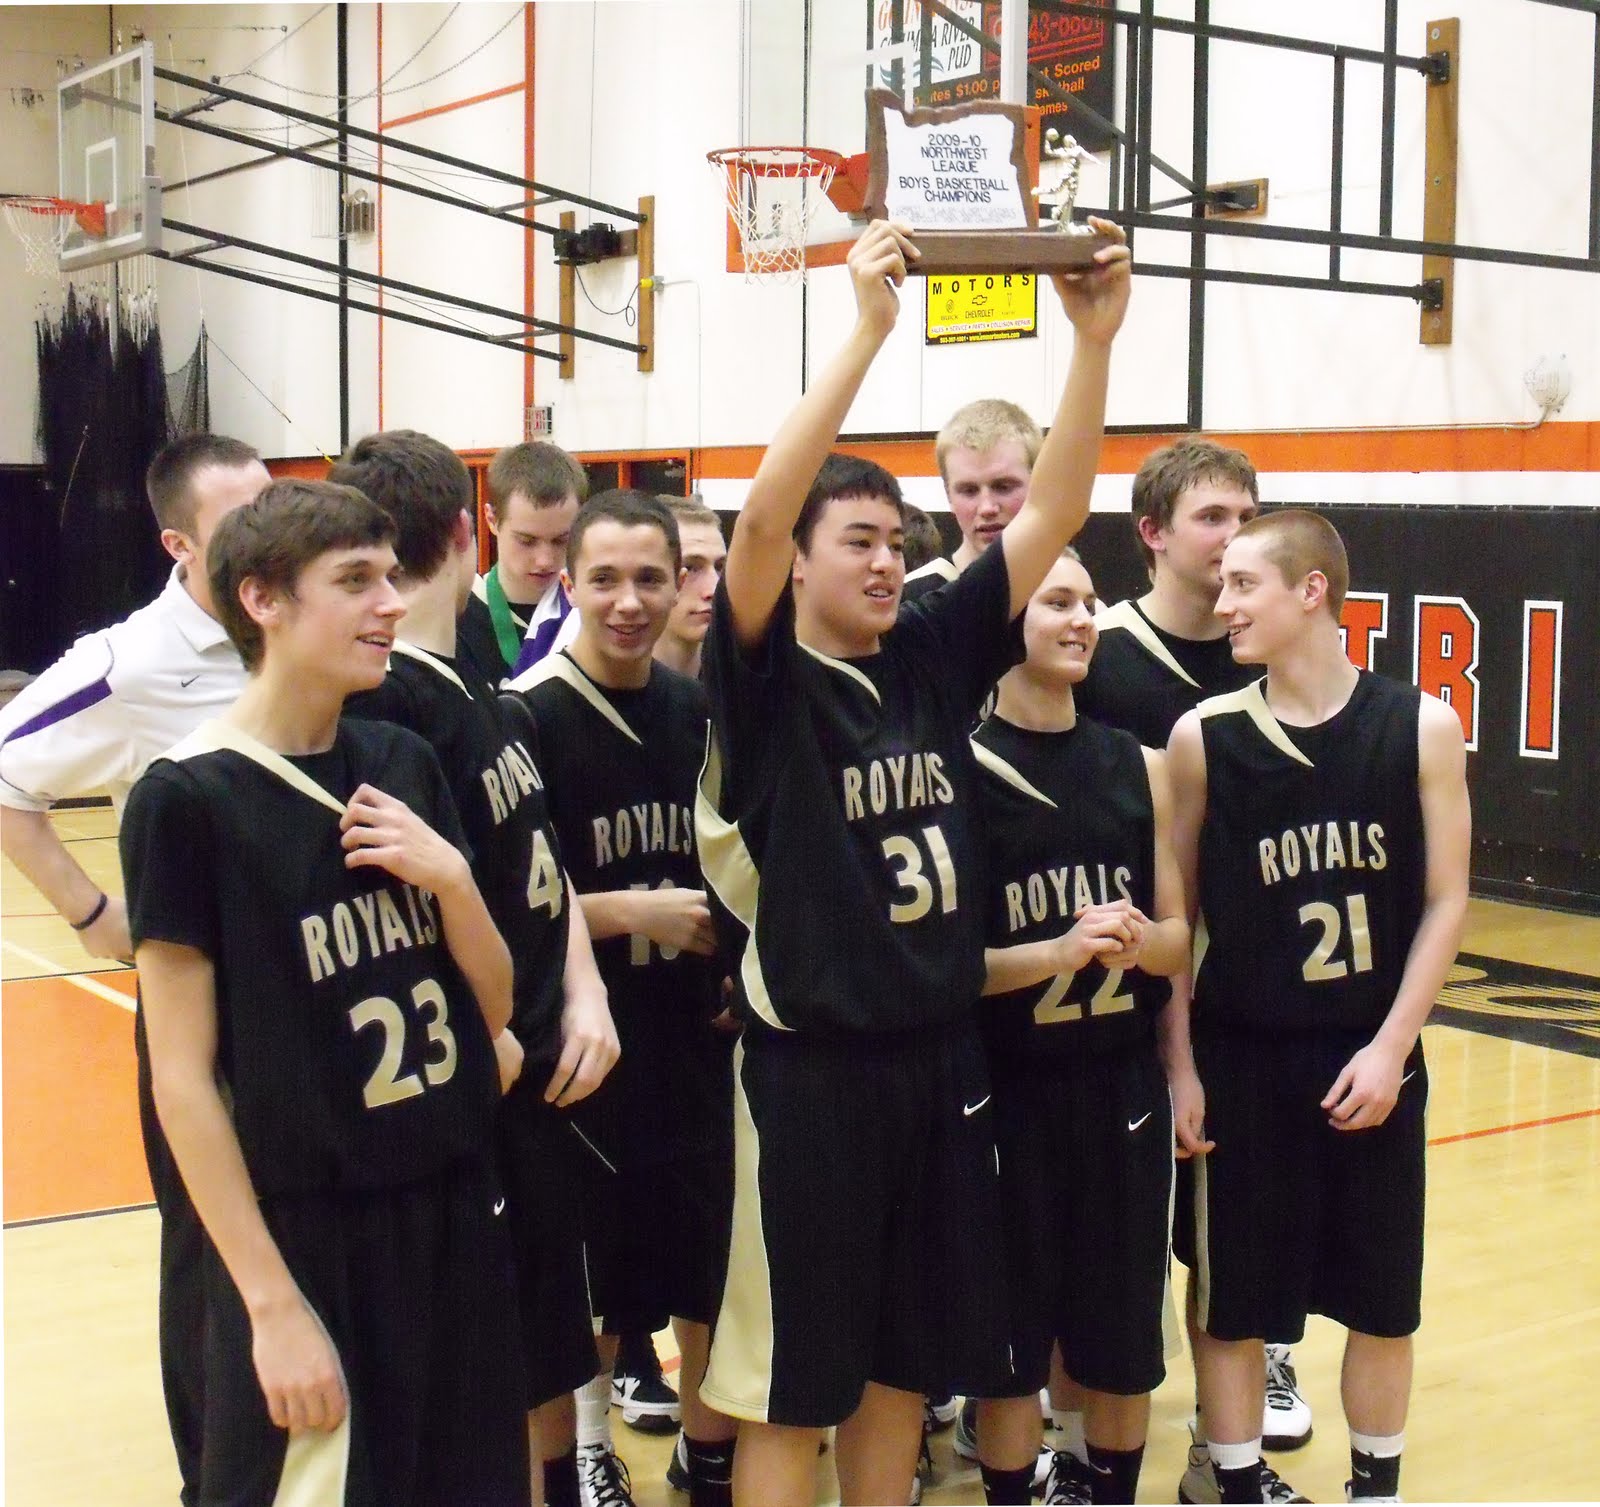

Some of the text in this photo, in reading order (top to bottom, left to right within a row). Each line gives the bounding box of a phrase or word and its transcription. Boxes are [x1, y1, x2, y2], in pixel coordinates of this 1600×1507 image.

[948, 43, 972, 71] PUD
[1054, 55, 1100, 79] Scored
[956, 79, 988, 98] $1.00
[1034, 101, 1068, 116] ames
[928, 133, 981, 147] 2009-10
[920, 146, 988, 160] NORTHWEST
[931, 160, 979, 173] LEAGUE
[898, 176, 1010, 191] BOYS BASKETBALL
[924, 190, 992, 203] CHAMPIONS
[965, 309, 995, 319] CHEVROLET
[843, 752, 954, 821] ROYALS
[593, 802, 692, 868] ROYALS
[1259, 822, 1387, 886] ROYALS
[882, 825, 957, 922] 31
[301, 884, 438, 982] ROYALS
[1298, 893, 1373, 982] 21
[349, 978, 457, 1109] 23
